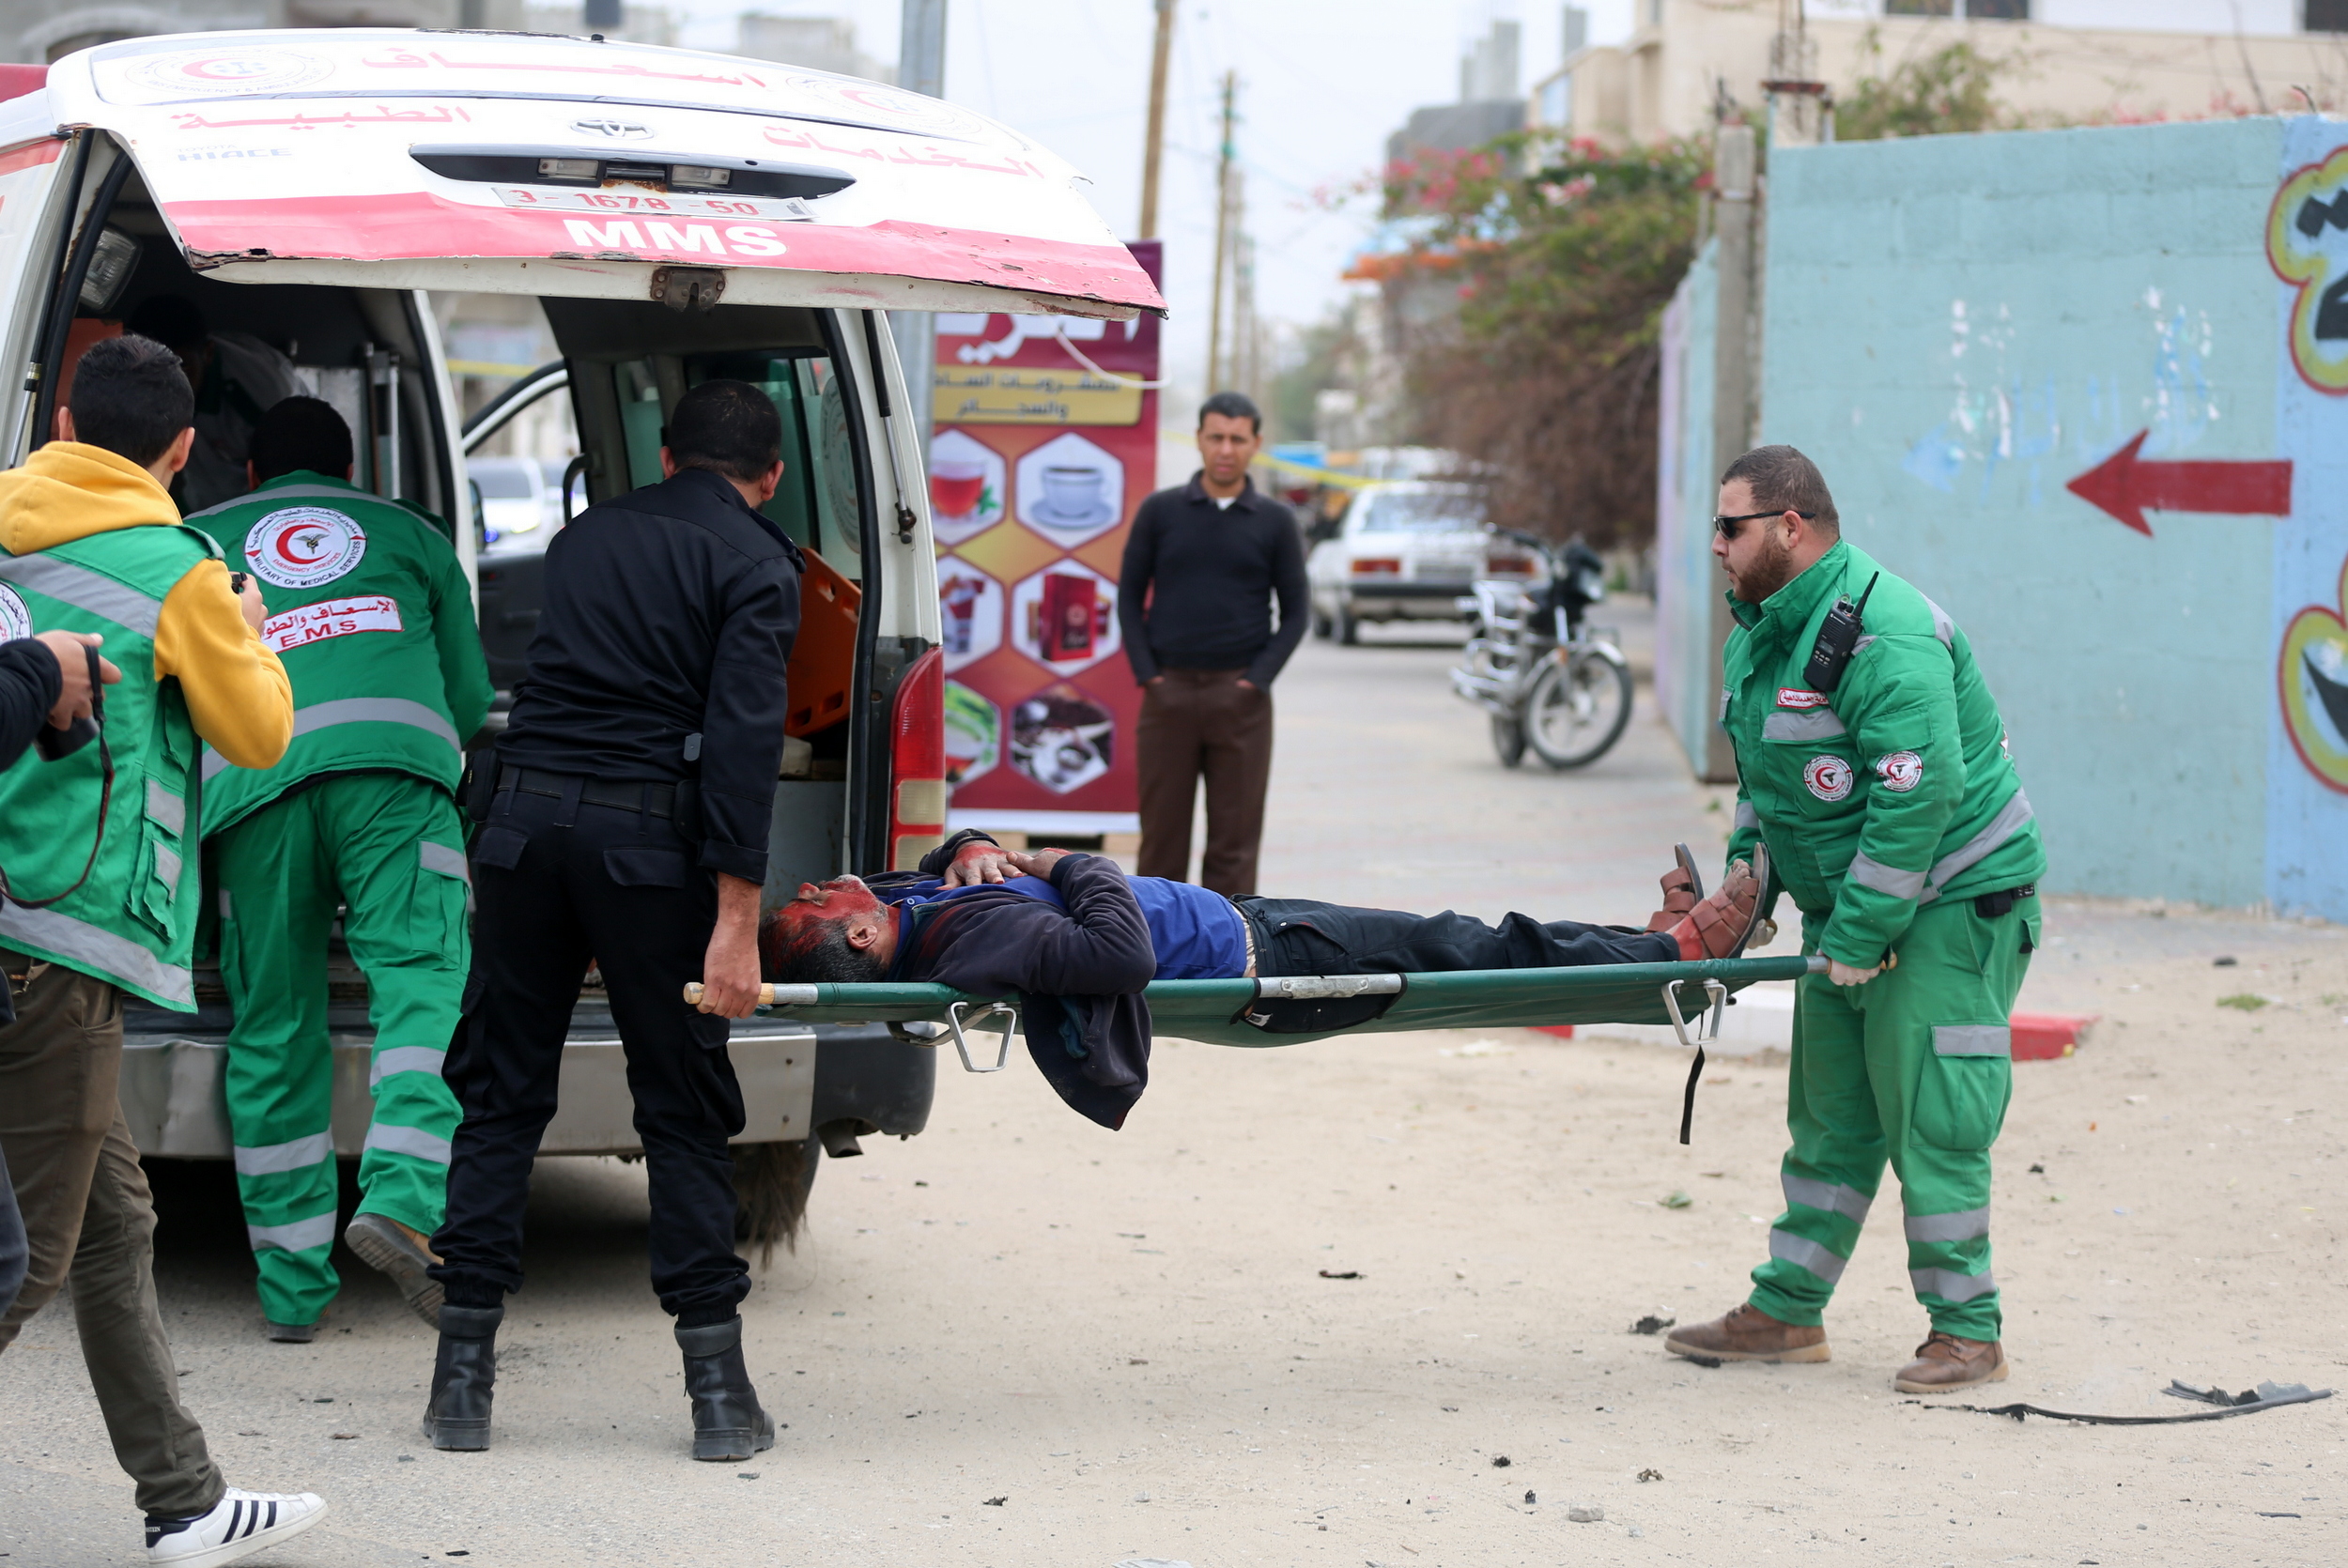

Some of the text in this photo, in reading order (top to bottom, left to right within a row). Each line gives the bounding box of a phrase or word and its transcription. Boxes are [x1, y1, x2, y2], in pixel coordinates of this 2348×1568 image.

[170, 105, 1045, 179] الخدمات الطبية
[176, 144, 238, 153] TOYOTA
[177, 147, 292, 161] HIACE
[562, 218, 788, 257] MMS
[254, 556, 284, 581] MILITARY
[300, 571, 340, 587] MEDICAL
[339, 541, 362, 572] SERVICES
[272, 552, 342, 573] EMERGENCY SERVICES
[311, 600, 397, 621] الإسعاف
[280, 620, 357, 648] E.M.S
